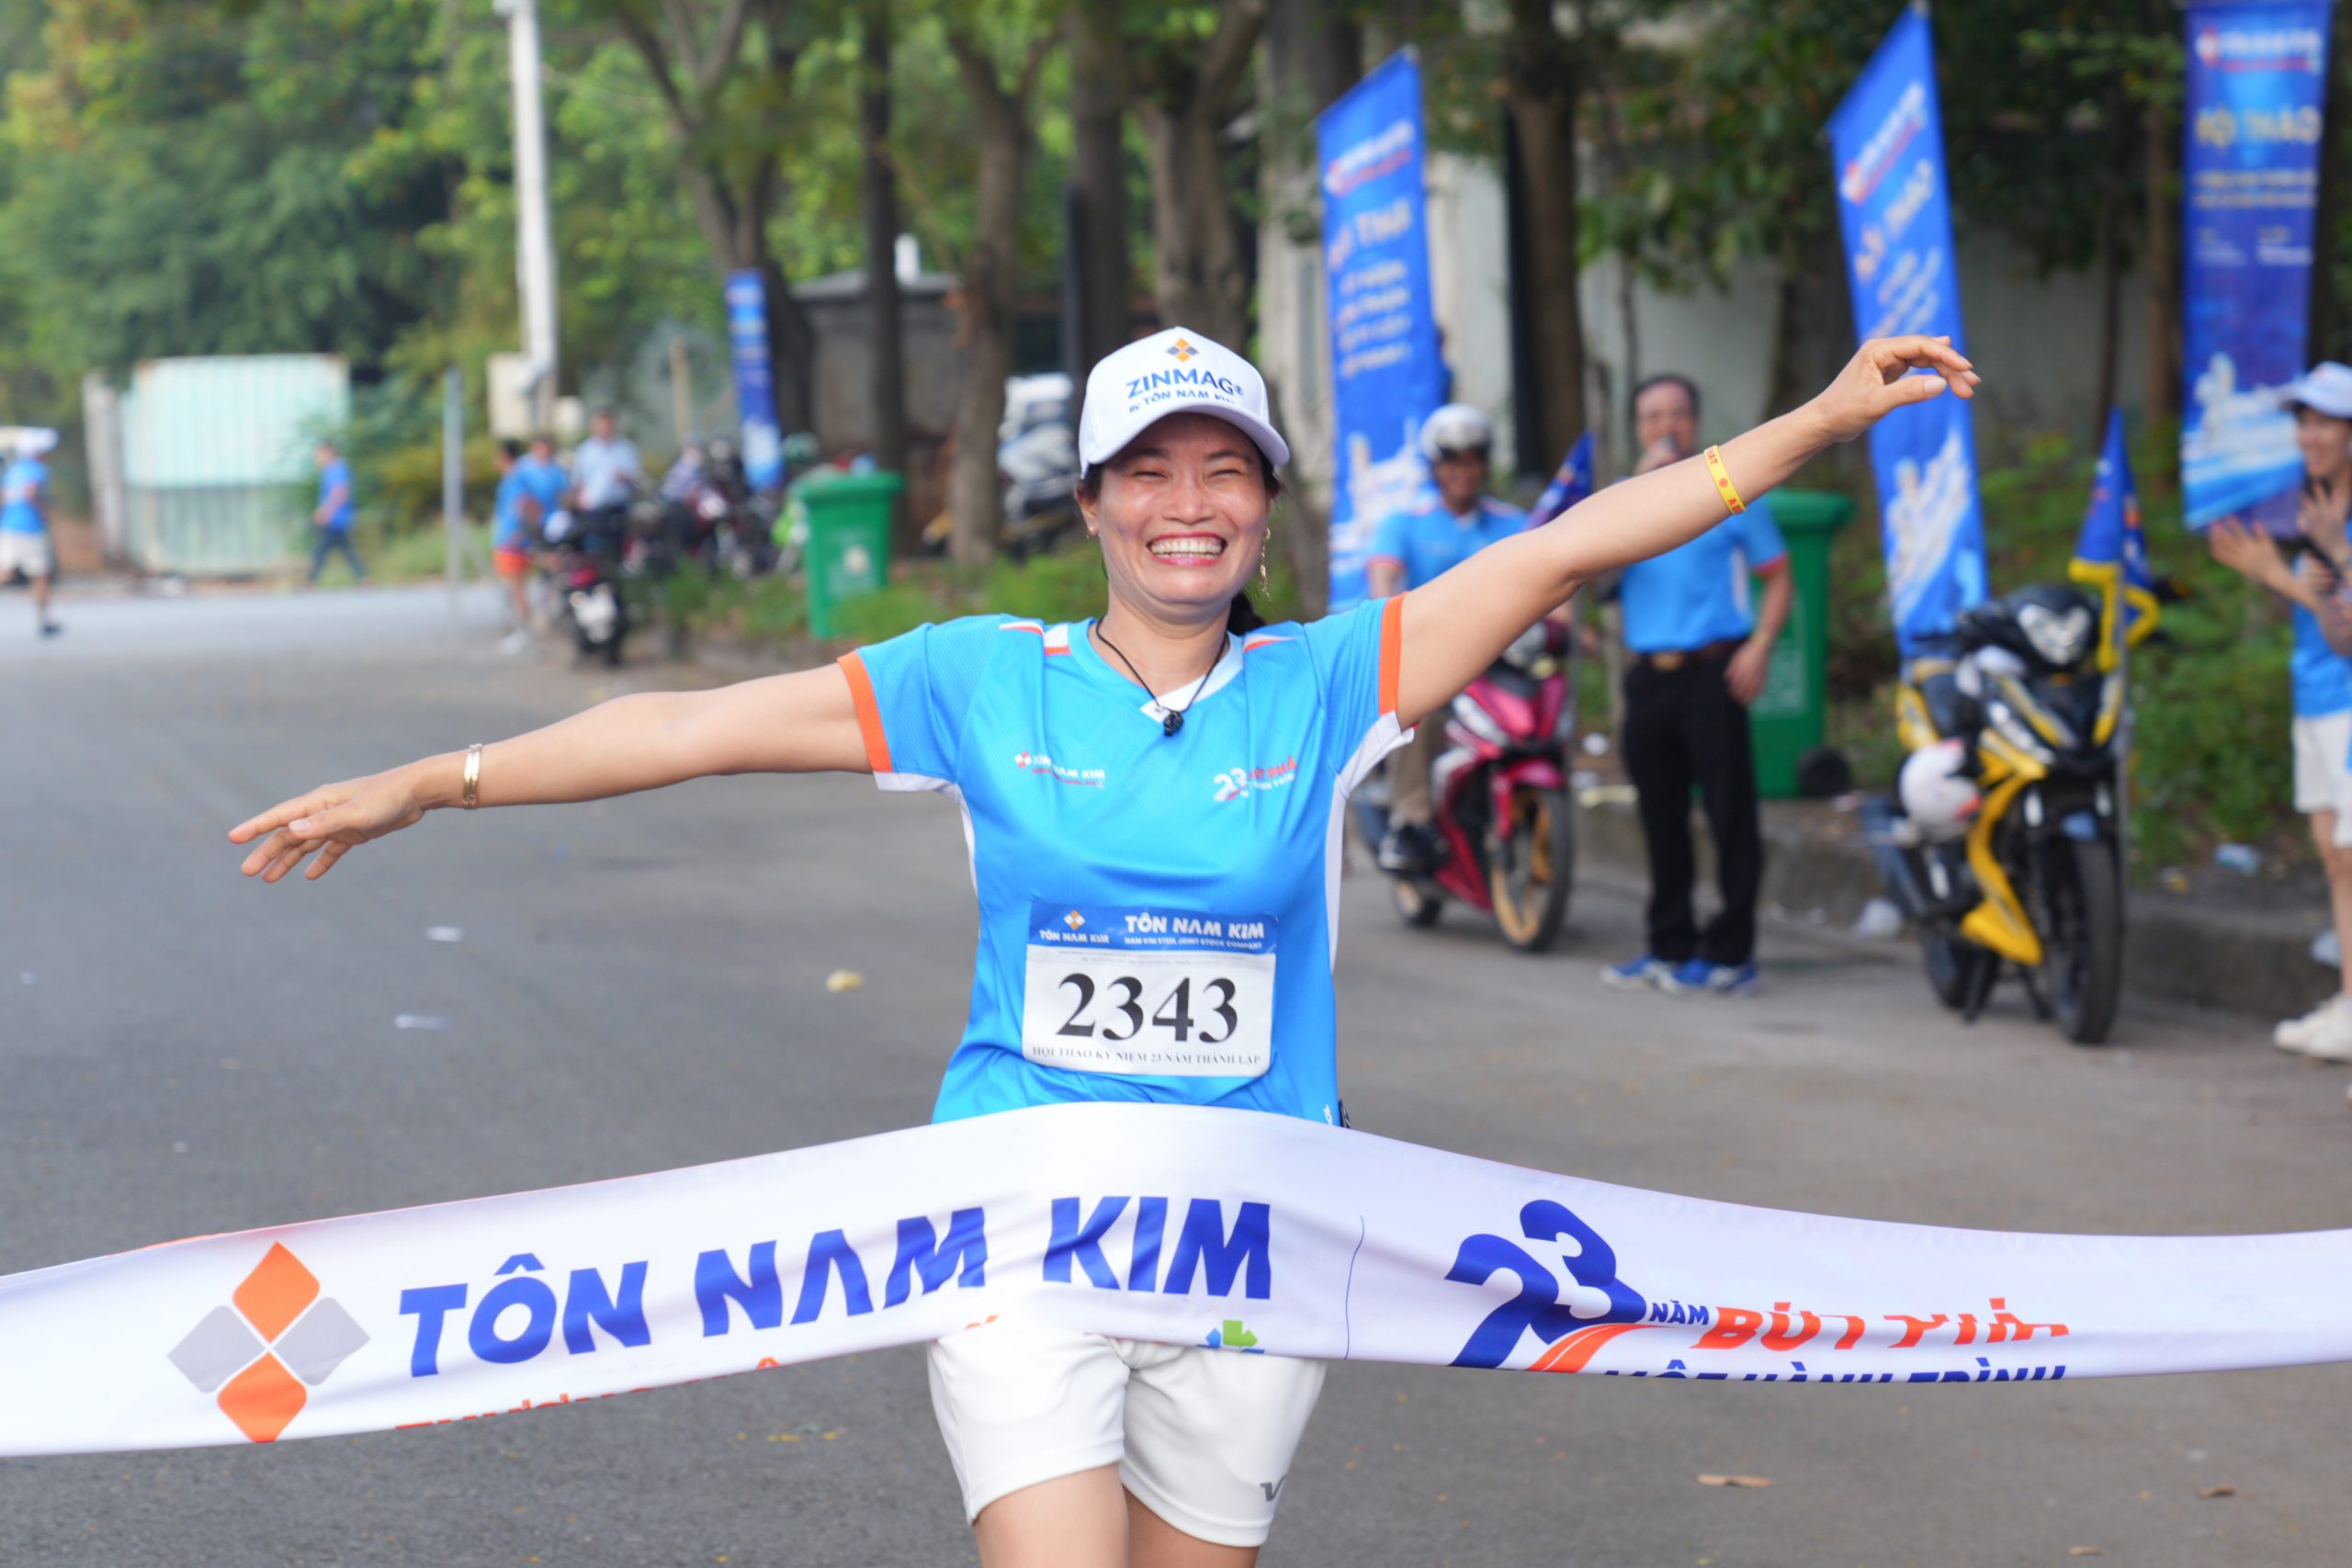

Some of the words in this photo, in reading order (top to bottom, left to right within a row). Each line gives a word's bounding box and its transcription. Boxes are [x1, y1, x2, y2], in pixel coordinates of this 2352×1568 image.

[1125, 911, 1168, 933] TÔN
[1172, 917, 1222, 937] NAM
[1228, 921, 1264, 939] KIM
[1056, 973, 1238, 1043] 2343
[399, 1252, 652, 1378] TÔN
[694, 1205, 989, 1338] NAM
[1042, 1195, 1272, 1300] KIM
